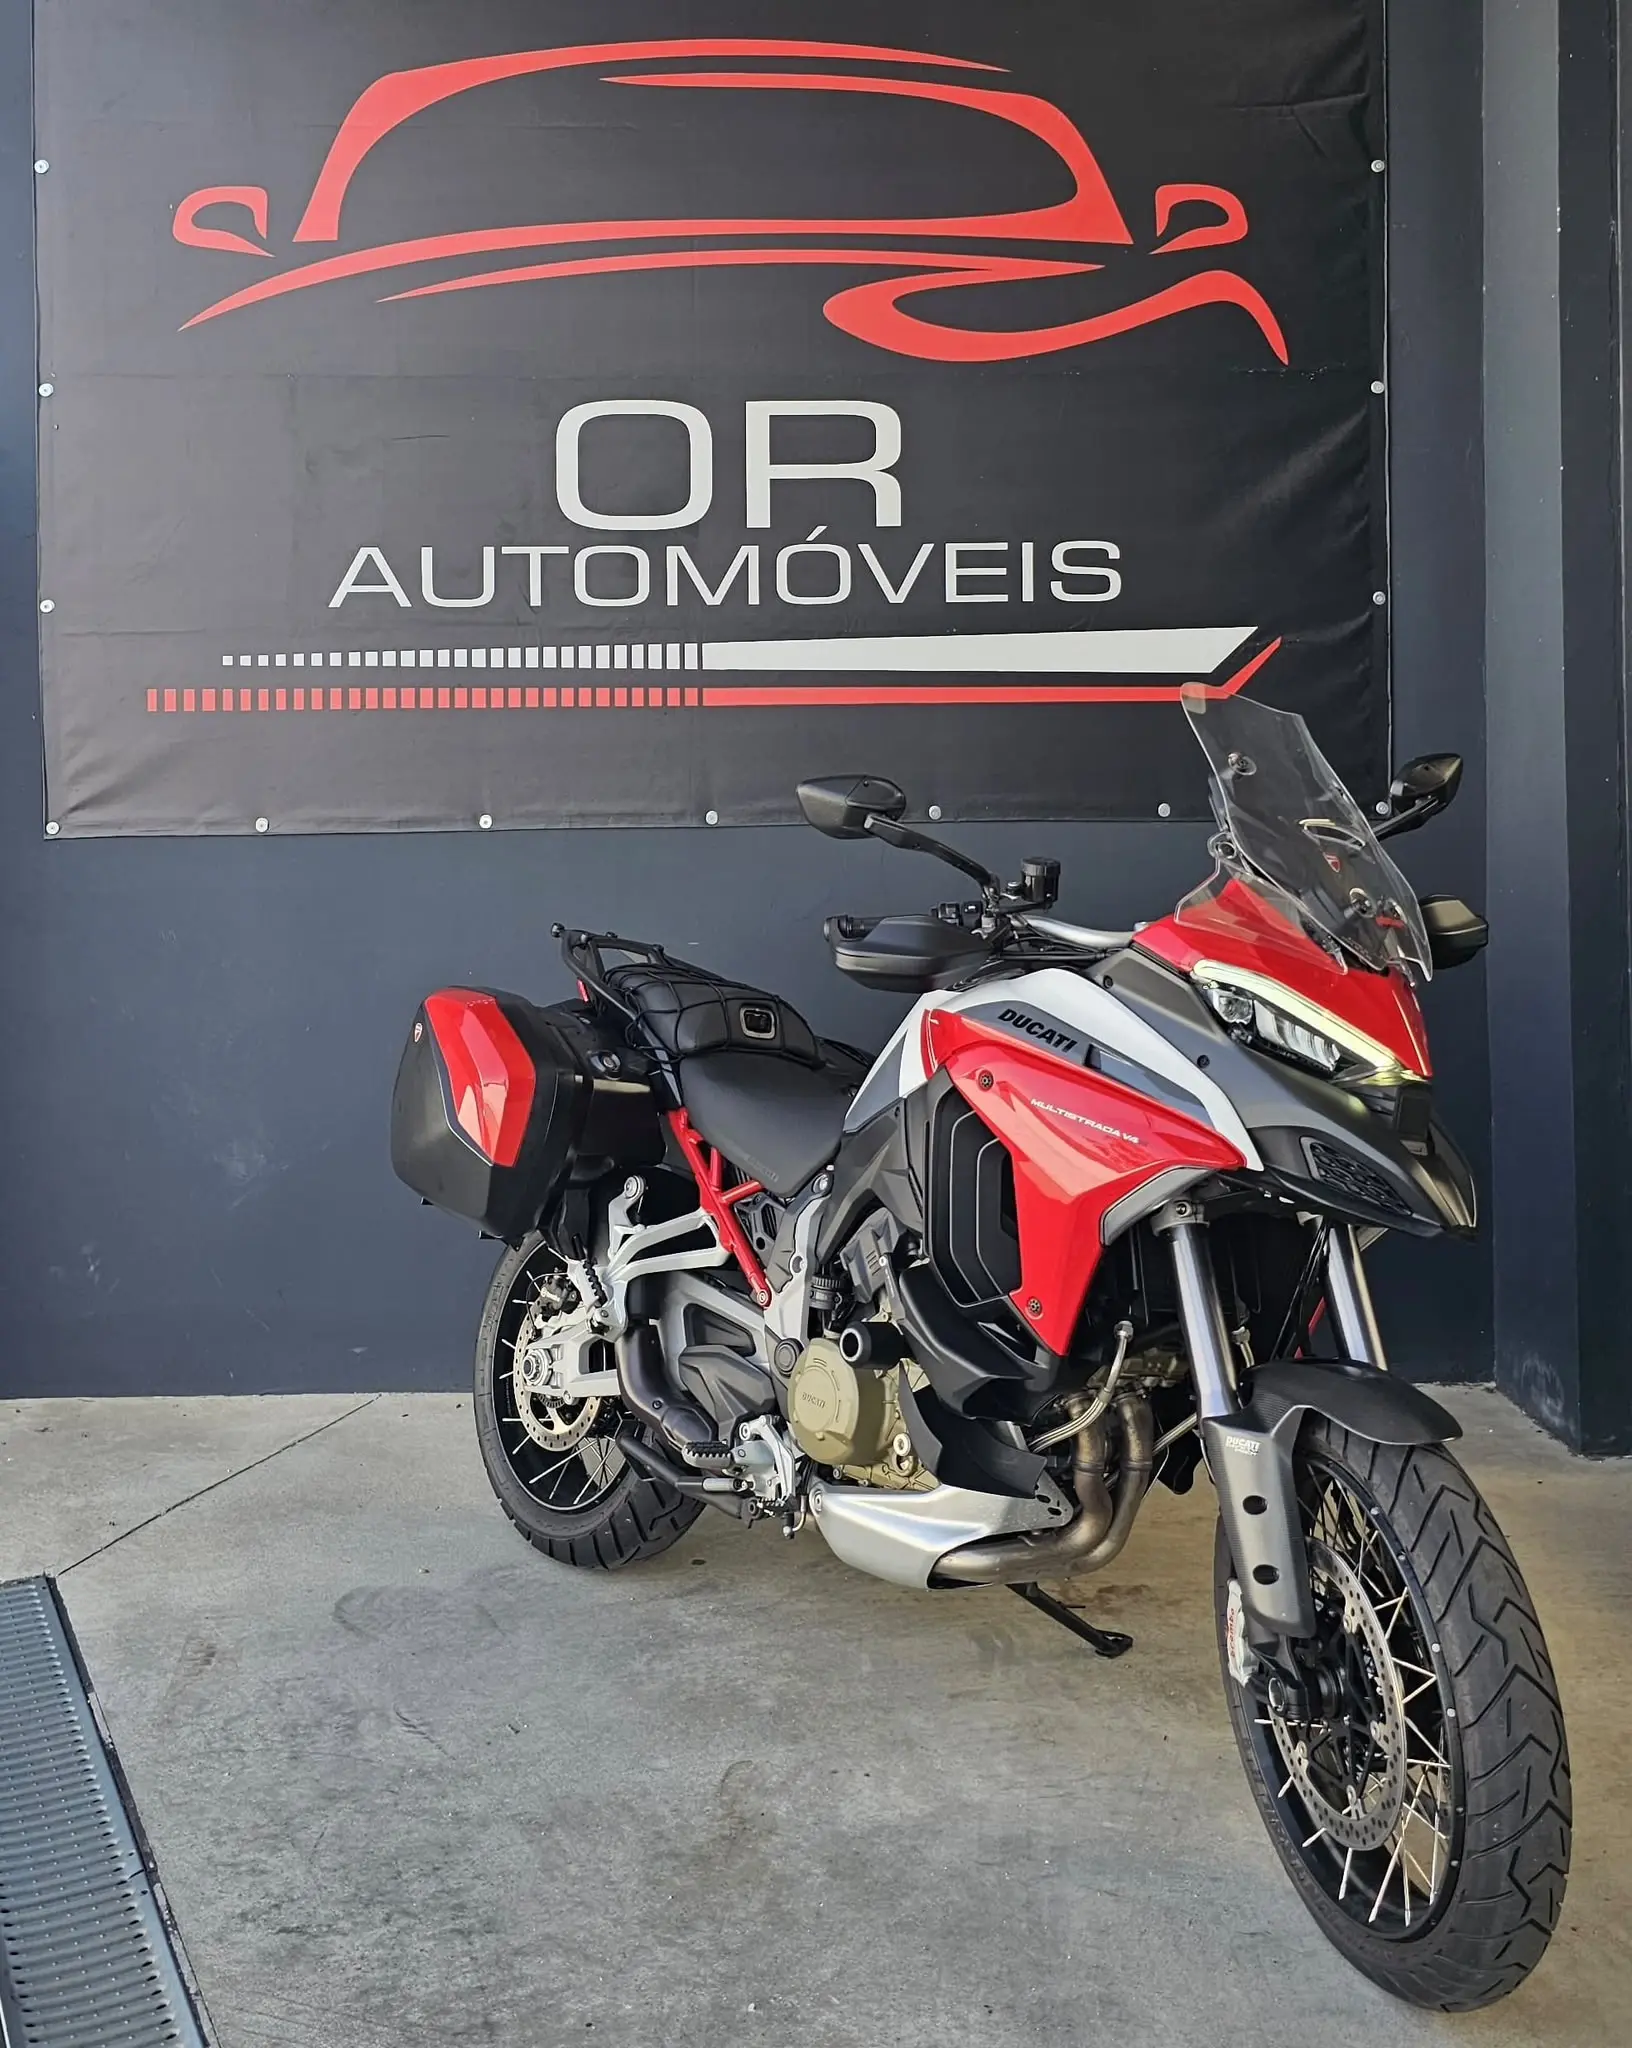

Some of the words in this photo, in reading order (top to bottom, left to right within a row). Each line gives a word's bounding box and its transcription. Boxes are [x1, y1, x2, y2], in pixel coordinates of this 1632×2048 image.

[555, 399, 902, 531] OR
[327, 526, 1123, 609] AUTOMÓVEIS
[998, 1008, 1078, 1053] DUCATI
[1030, 1098, 1121, 1138] MULTISTRADA
[1122, 1132, 1140, 1145] V4
[1225, 1435, 1262, 1450] DUCATI
